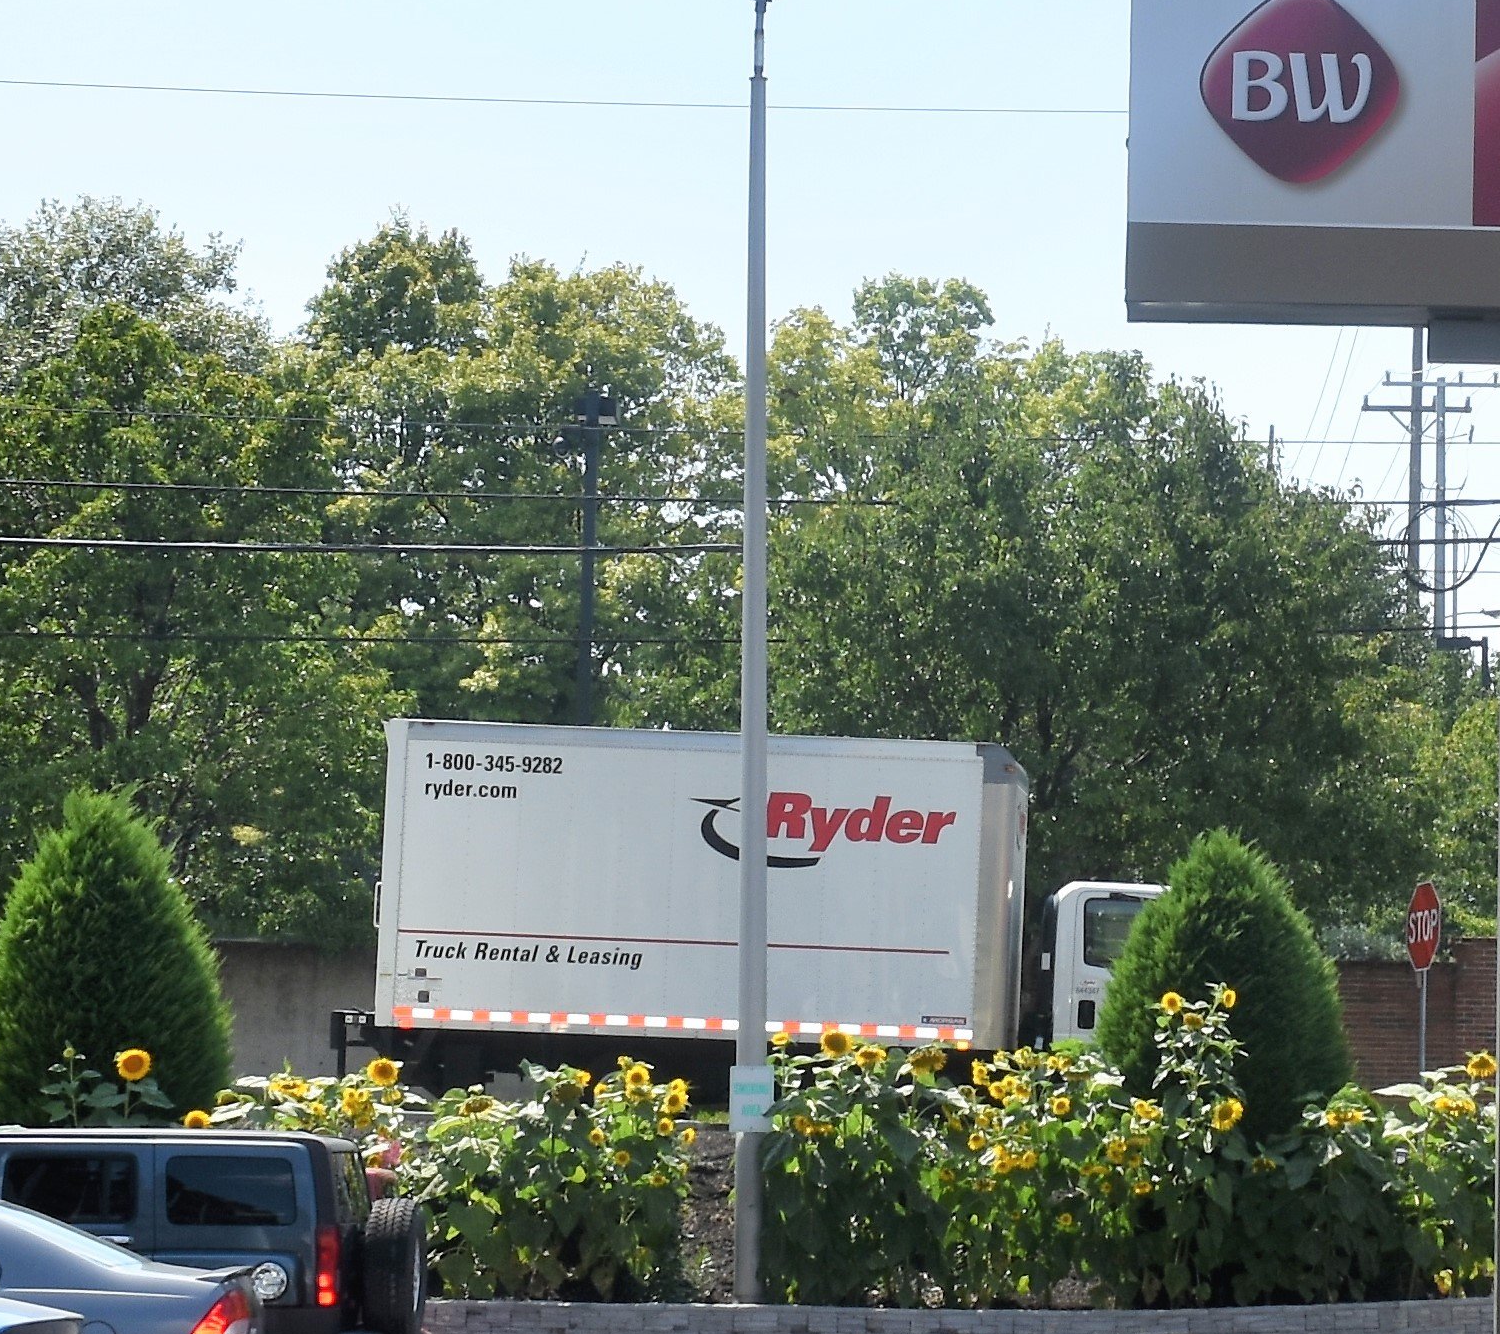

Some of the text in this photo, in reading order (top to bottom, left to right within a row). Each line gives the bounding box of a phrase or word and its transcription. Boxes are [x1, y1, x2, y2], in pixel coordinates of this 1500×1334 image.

[1230, 50, 1373, 126] BW
[425, 752, 564, 774] 1-800-345-9282
[424, 778, 518, 800] ryder.com
[766, 791, 957, 853] Ryder
[1408, 908, 1438, 944] STOP
[415, 939, 643, 970] Truck Rental & Leasing
